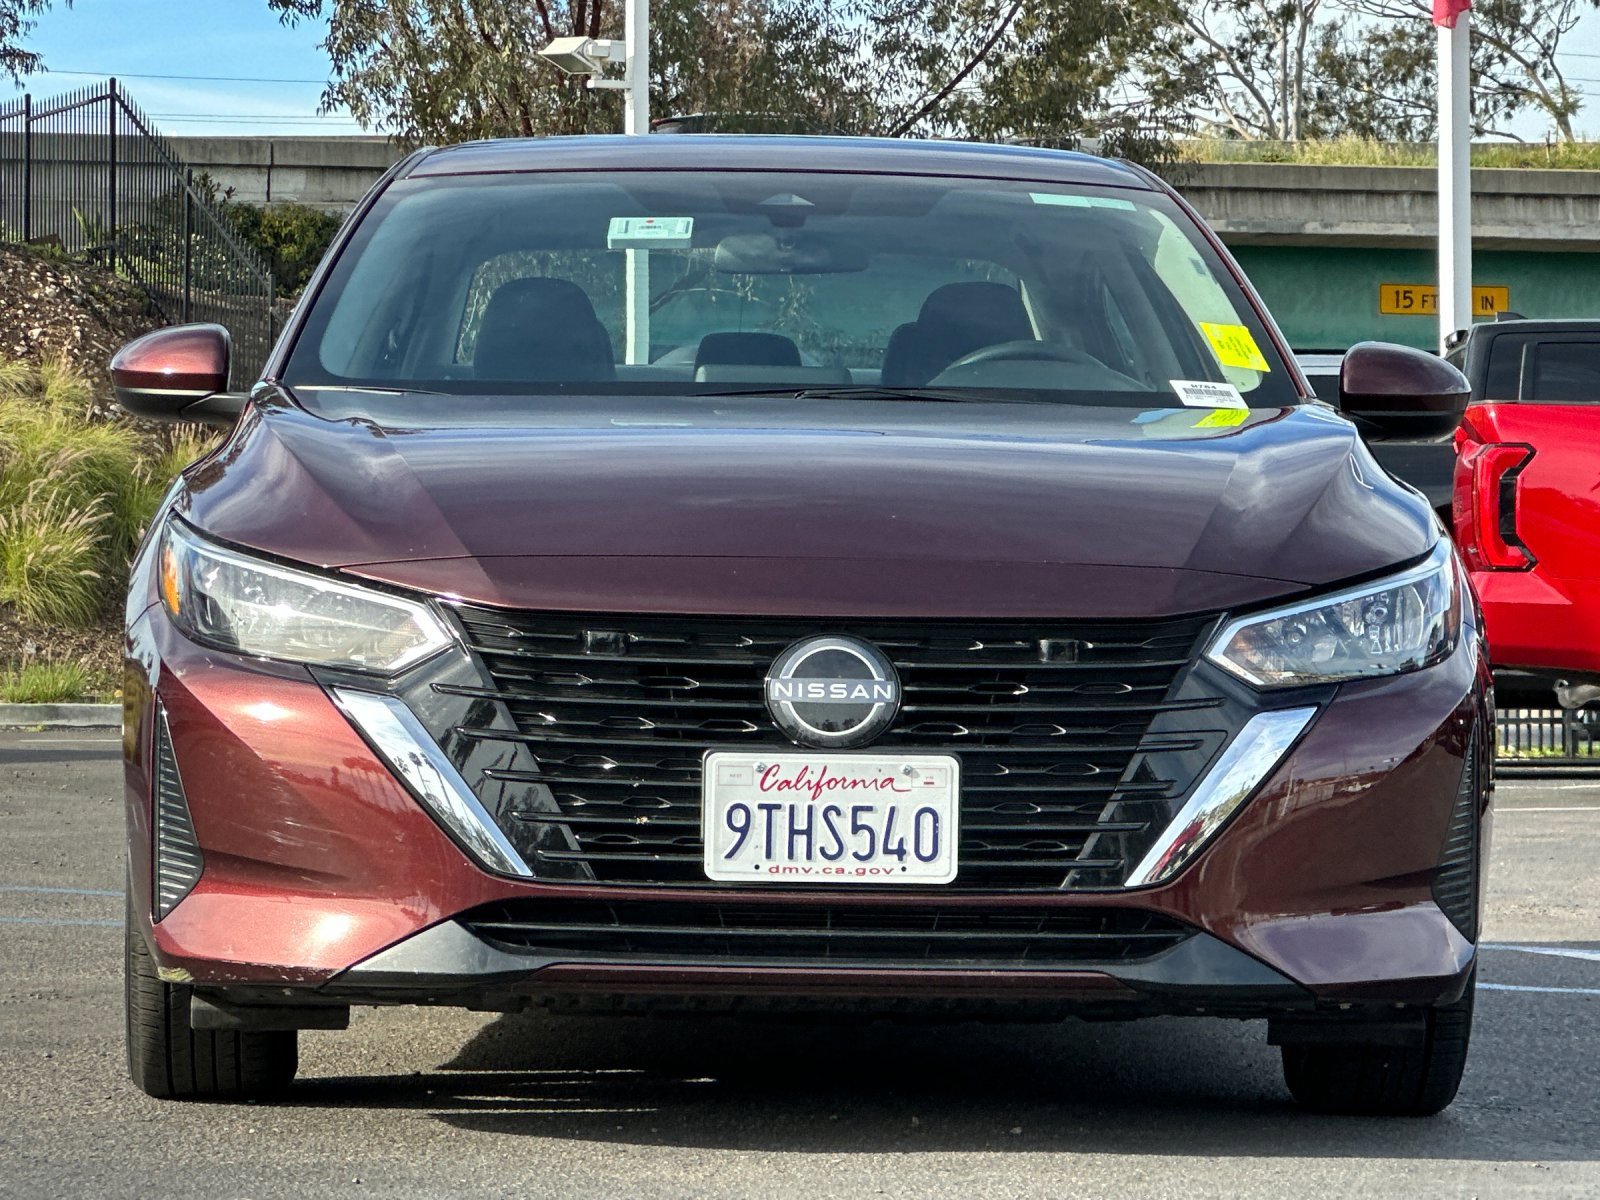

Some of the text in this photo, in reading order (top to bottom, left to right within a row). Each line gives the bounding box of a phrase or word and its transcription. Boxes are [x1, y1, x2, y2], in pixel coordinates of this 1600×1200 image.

[1395, 290, 1494, 310] 15 FT IN
[774, 681, 892, 699] NISSAN
[760, 764, 912, 801] California
[724, 803, 940, 862] 9THS540
[768, 865, 894, 876] dmv.ca.gov
